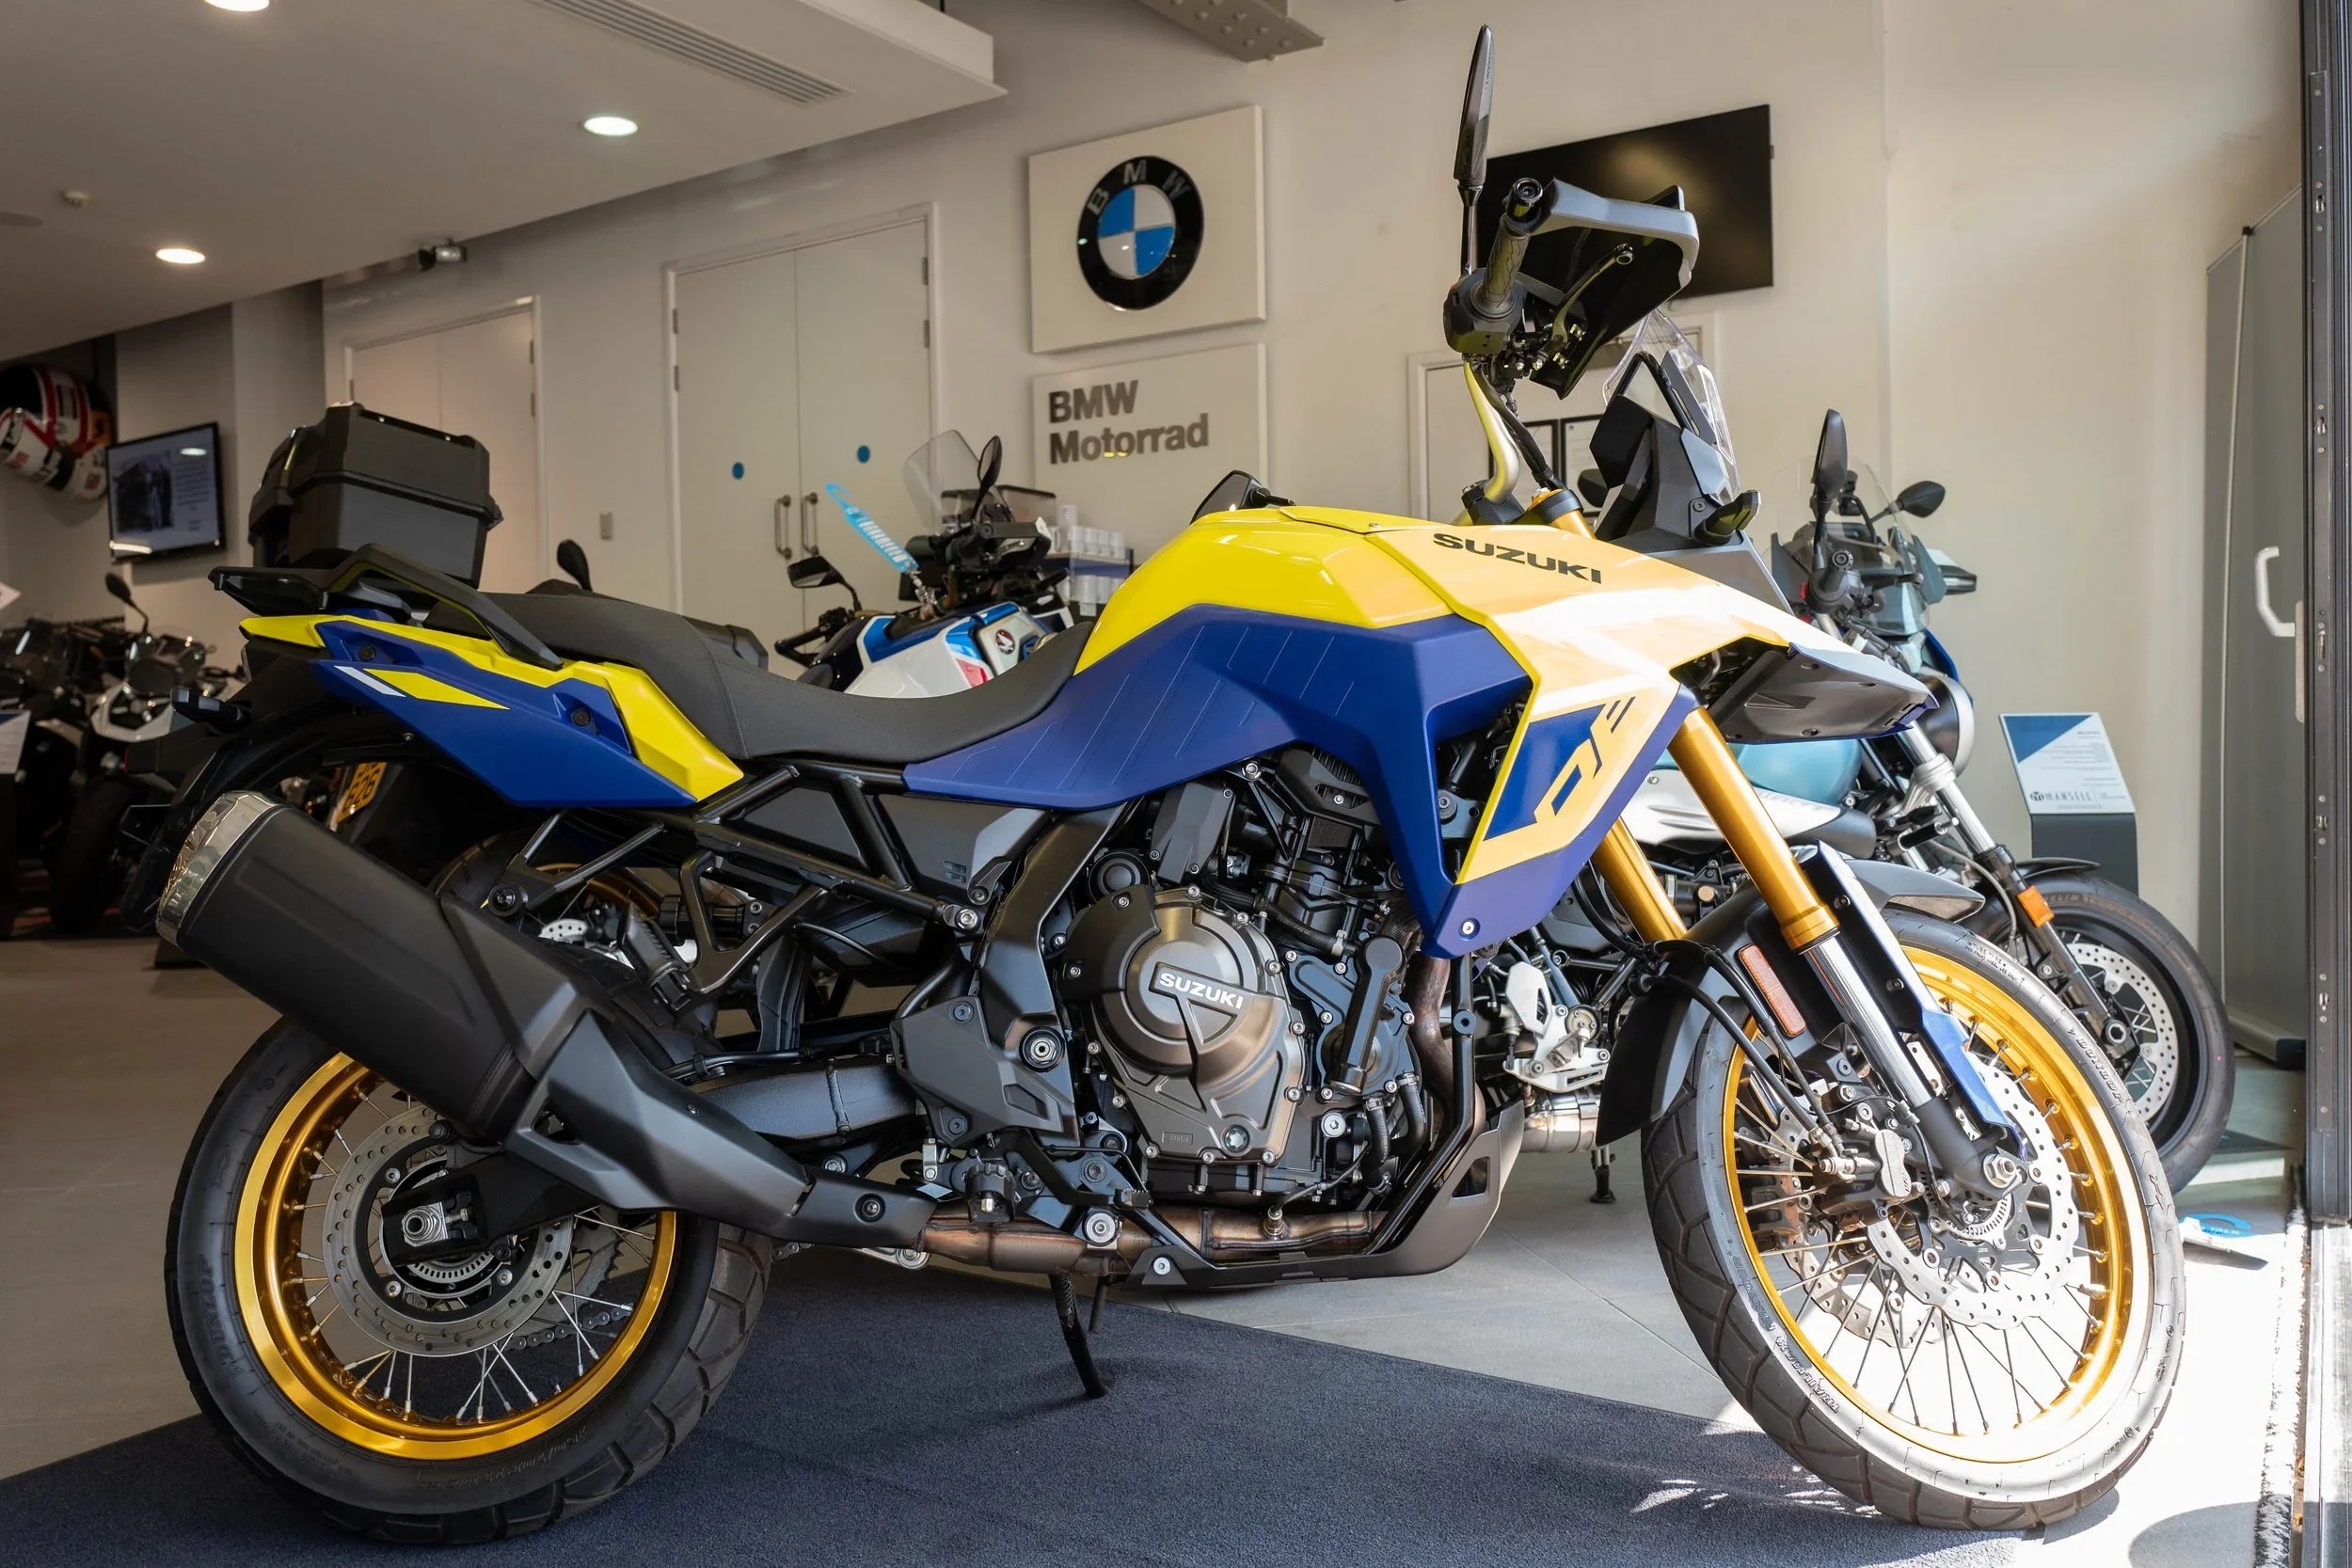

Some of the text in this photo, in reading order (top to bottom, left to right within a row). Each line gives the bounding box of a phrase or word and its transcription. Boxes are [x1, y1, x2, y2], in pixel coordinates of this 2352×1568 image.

[1087, 159, 1190, 215] BMW
[1048, 379, 1139, 423] BMW
[1049, 413, 1209, 464] Motorrad
[1433, 532, 1602, 584] SUZUKI
[1159, 972, 1244, 1009] SUZUKI
[2075, 1038, 2123, 1103] DUNLOP
[199, 1259, 235, 1361] DUNLOP
[1776, 1335, 1840, 1414] TRAILMAX
